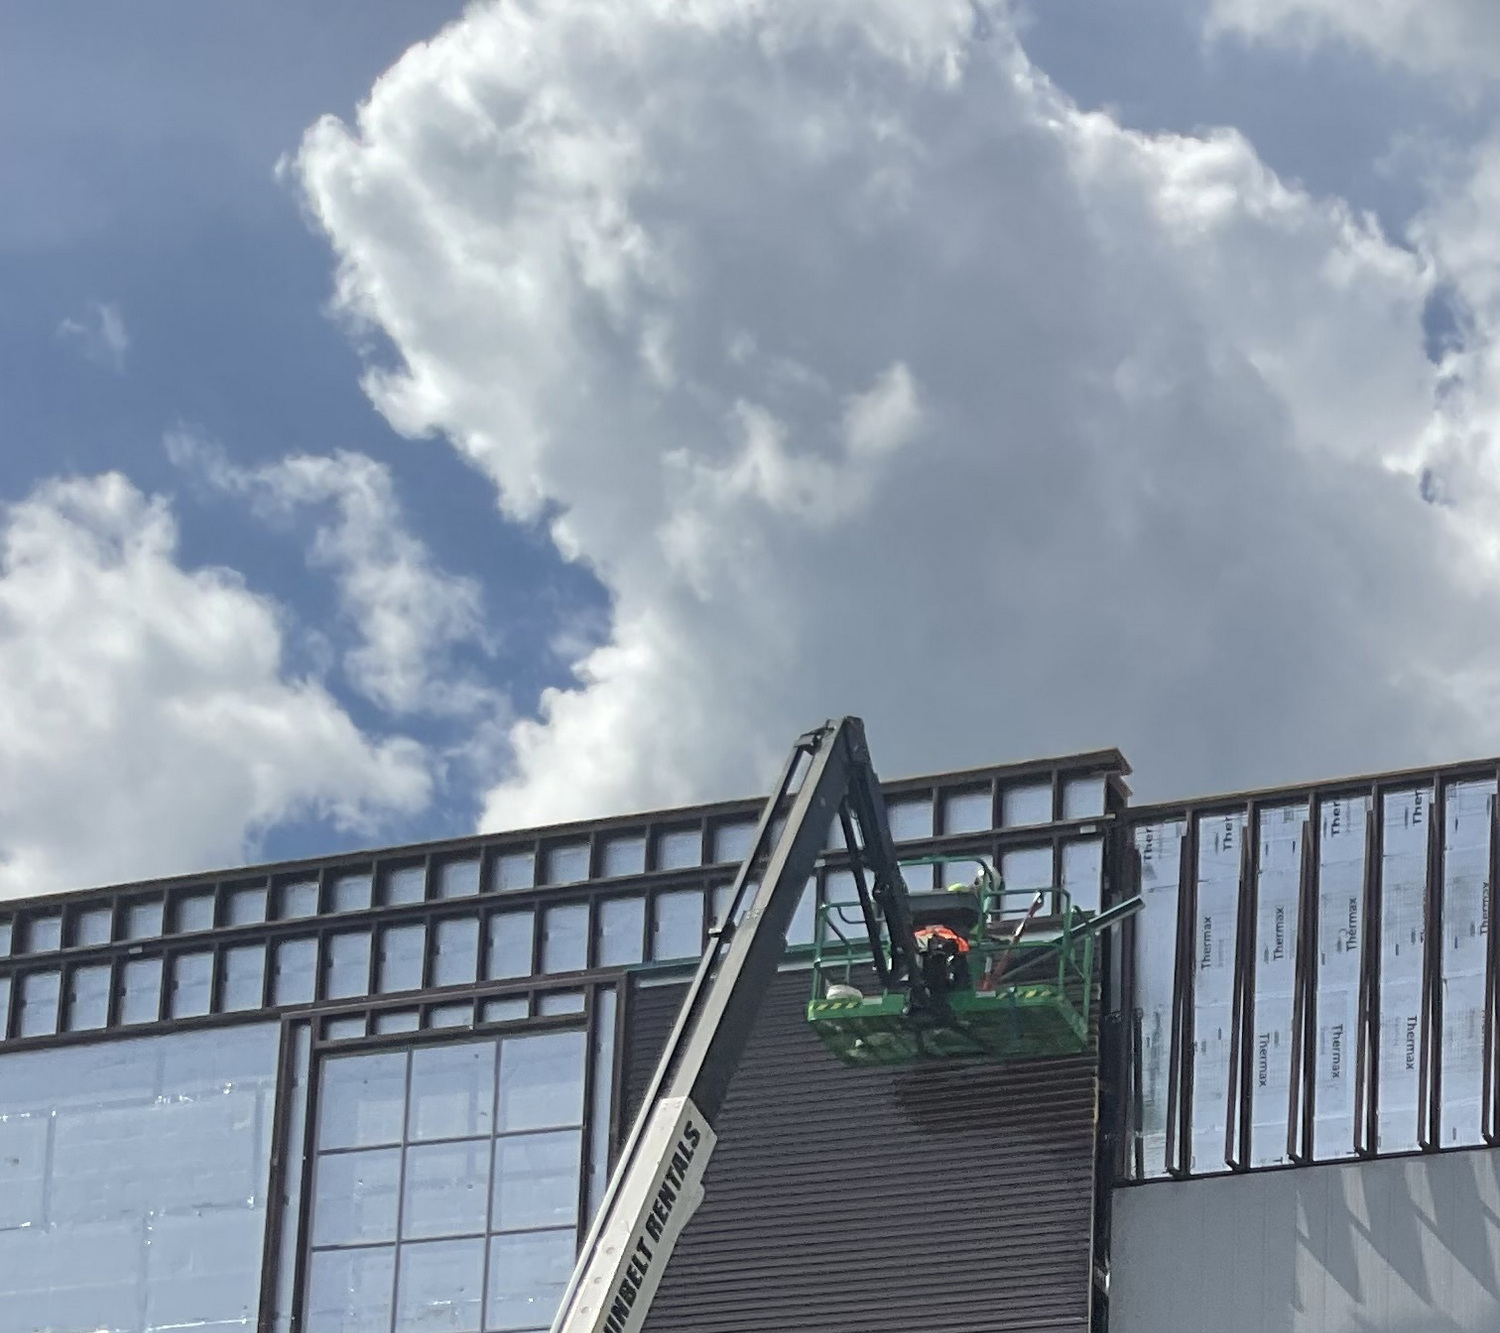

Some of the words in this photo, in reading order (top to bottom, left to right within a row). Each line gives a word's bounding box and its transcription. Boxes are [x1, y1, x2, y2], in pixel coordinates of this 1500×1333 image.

[1202, 916, 1212, 970] Thermax
[1273, 906, 1284, 962] Thermax
[1346, 897, 1358, 951] Thermax
[1259, 1033, 1270, 1088] Thermax
[1331, 1023, 1343, 1079] Thermax
[1405, 1015, 1418, 1070] Thermax
[645, 1120, 701, 1243] RENTALS
